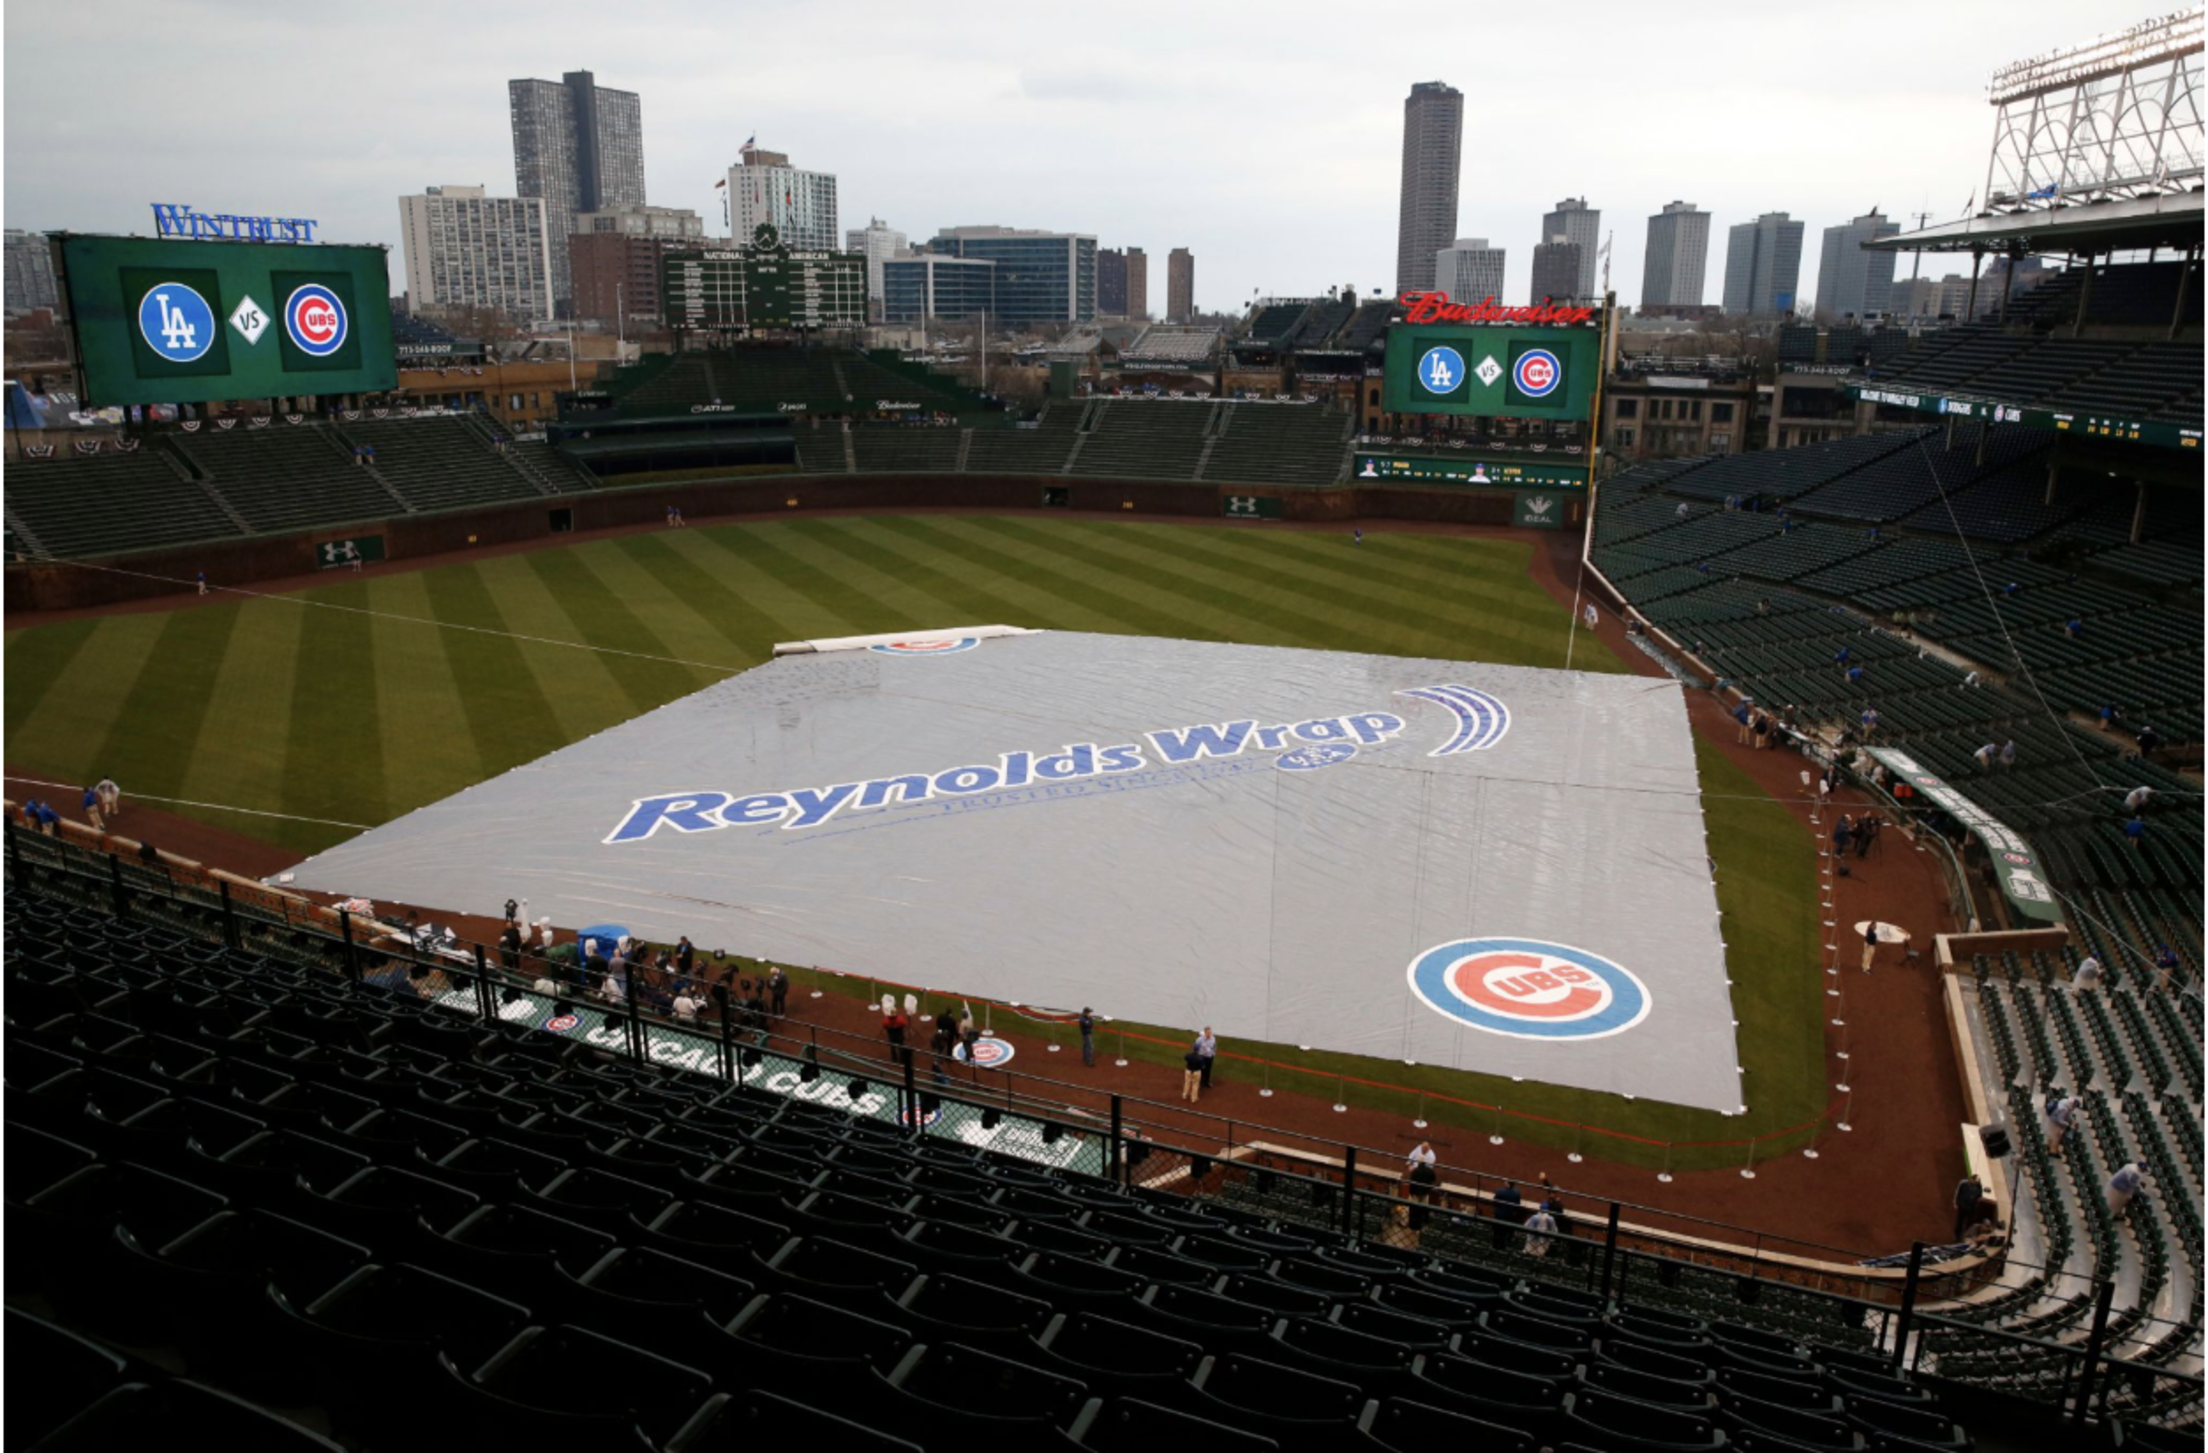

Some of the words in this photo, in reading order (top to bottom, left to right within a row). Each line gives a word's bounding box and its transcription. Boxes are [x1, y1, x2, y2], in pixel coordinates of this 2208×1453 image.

[150, 203, 318, 242] WINTRUST
[704, 251, 746, 259] NATIONAL
[156, 294, 196, 349] LA
[240, 311, 260, 331] VS
[297, 297, 337, 342] CUBS
[1400, 291, 1594, 323] Budweiser
[1430, 353, 1452, 386] LA
[1482, 364, 1496, 378] VS
[602, 743, 1148, 845] Reynolds
[1146, 711, 1407, 766] Wrap
[1453, 953, 1603, 1018] CUBS
[765, 1071, 887, 1115] CUBS
